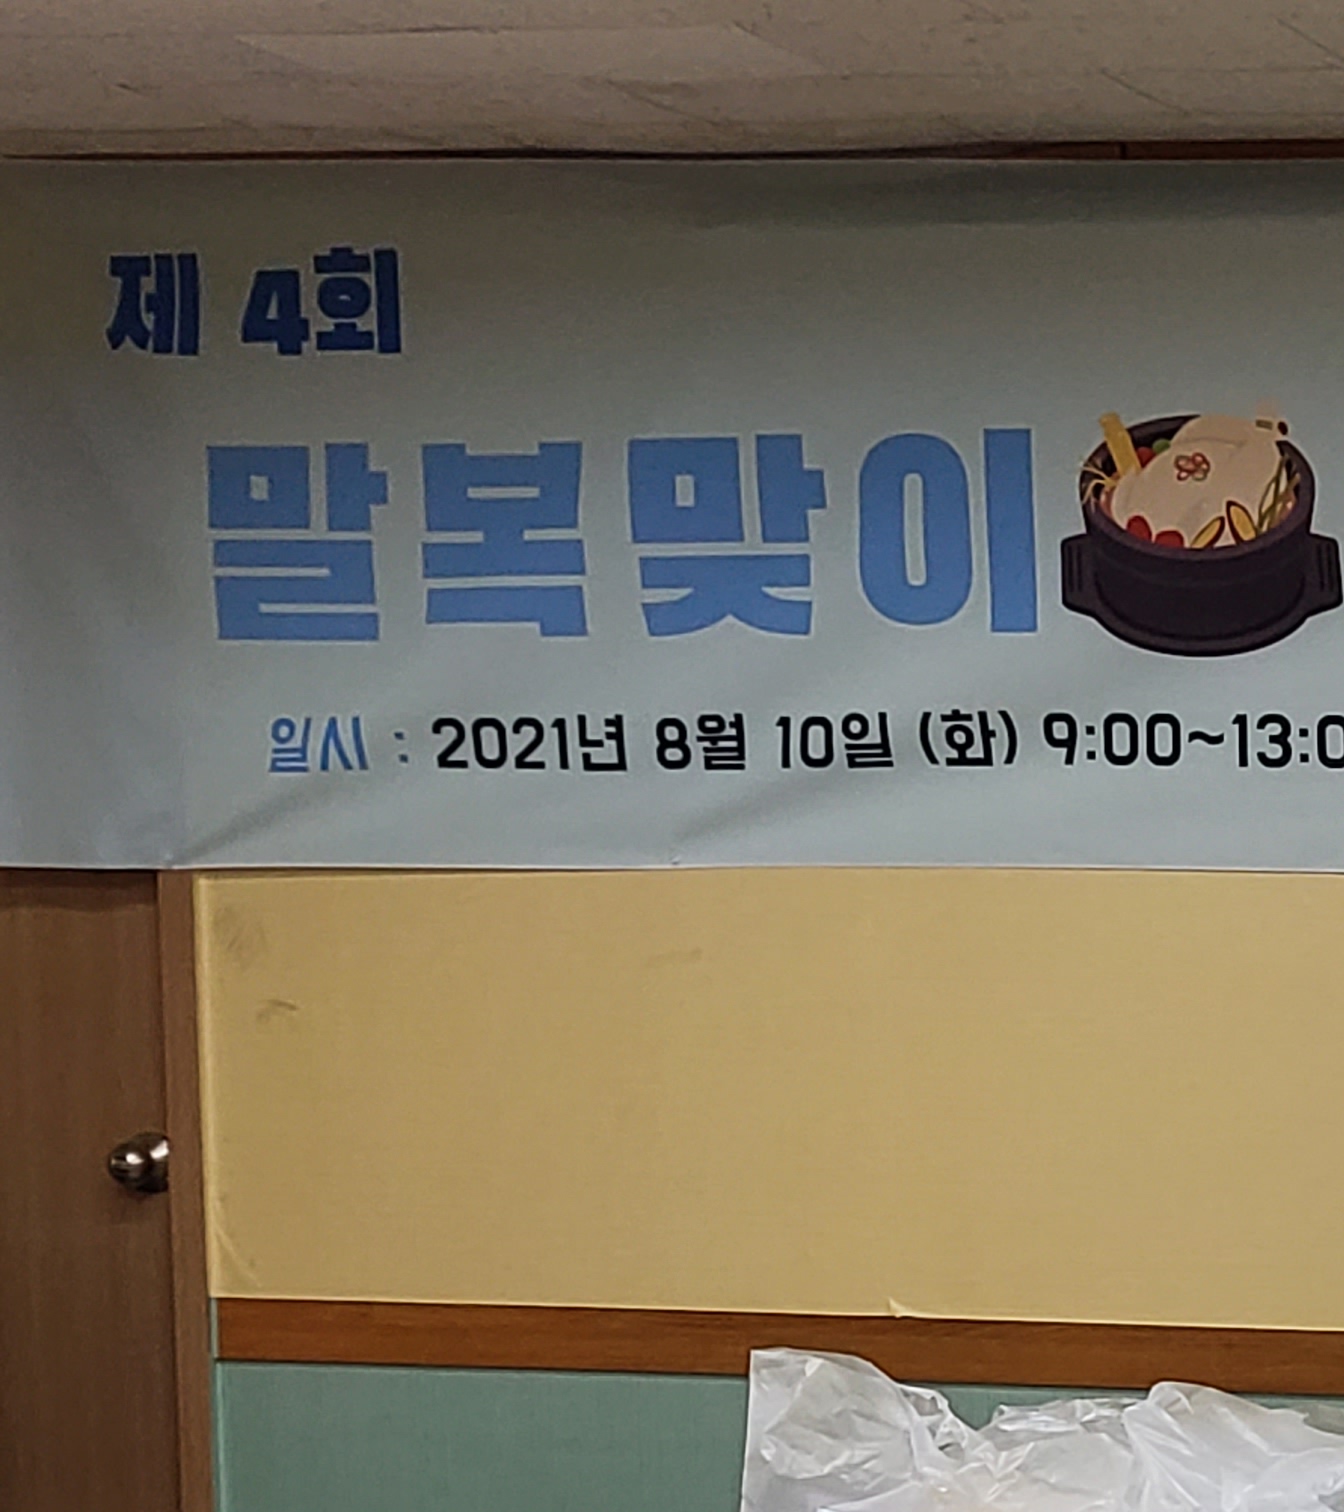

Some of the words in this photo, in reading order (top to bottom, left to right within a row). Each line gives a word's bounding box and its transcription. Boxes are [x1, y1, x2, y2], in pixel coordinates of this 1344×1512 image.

[105, 250, 199, 356] 제
[240, 245, 402, 355] 4회
[205, 427, 1039, 643] 말복맞이
[267, 716, 367, 774] 일시
[431, 714, 630, 773] 2021년
[654, 713, 750, 772] 8월
[773, 713, 897, 771] 10일
[917, 709, 1020, 770] (화)
